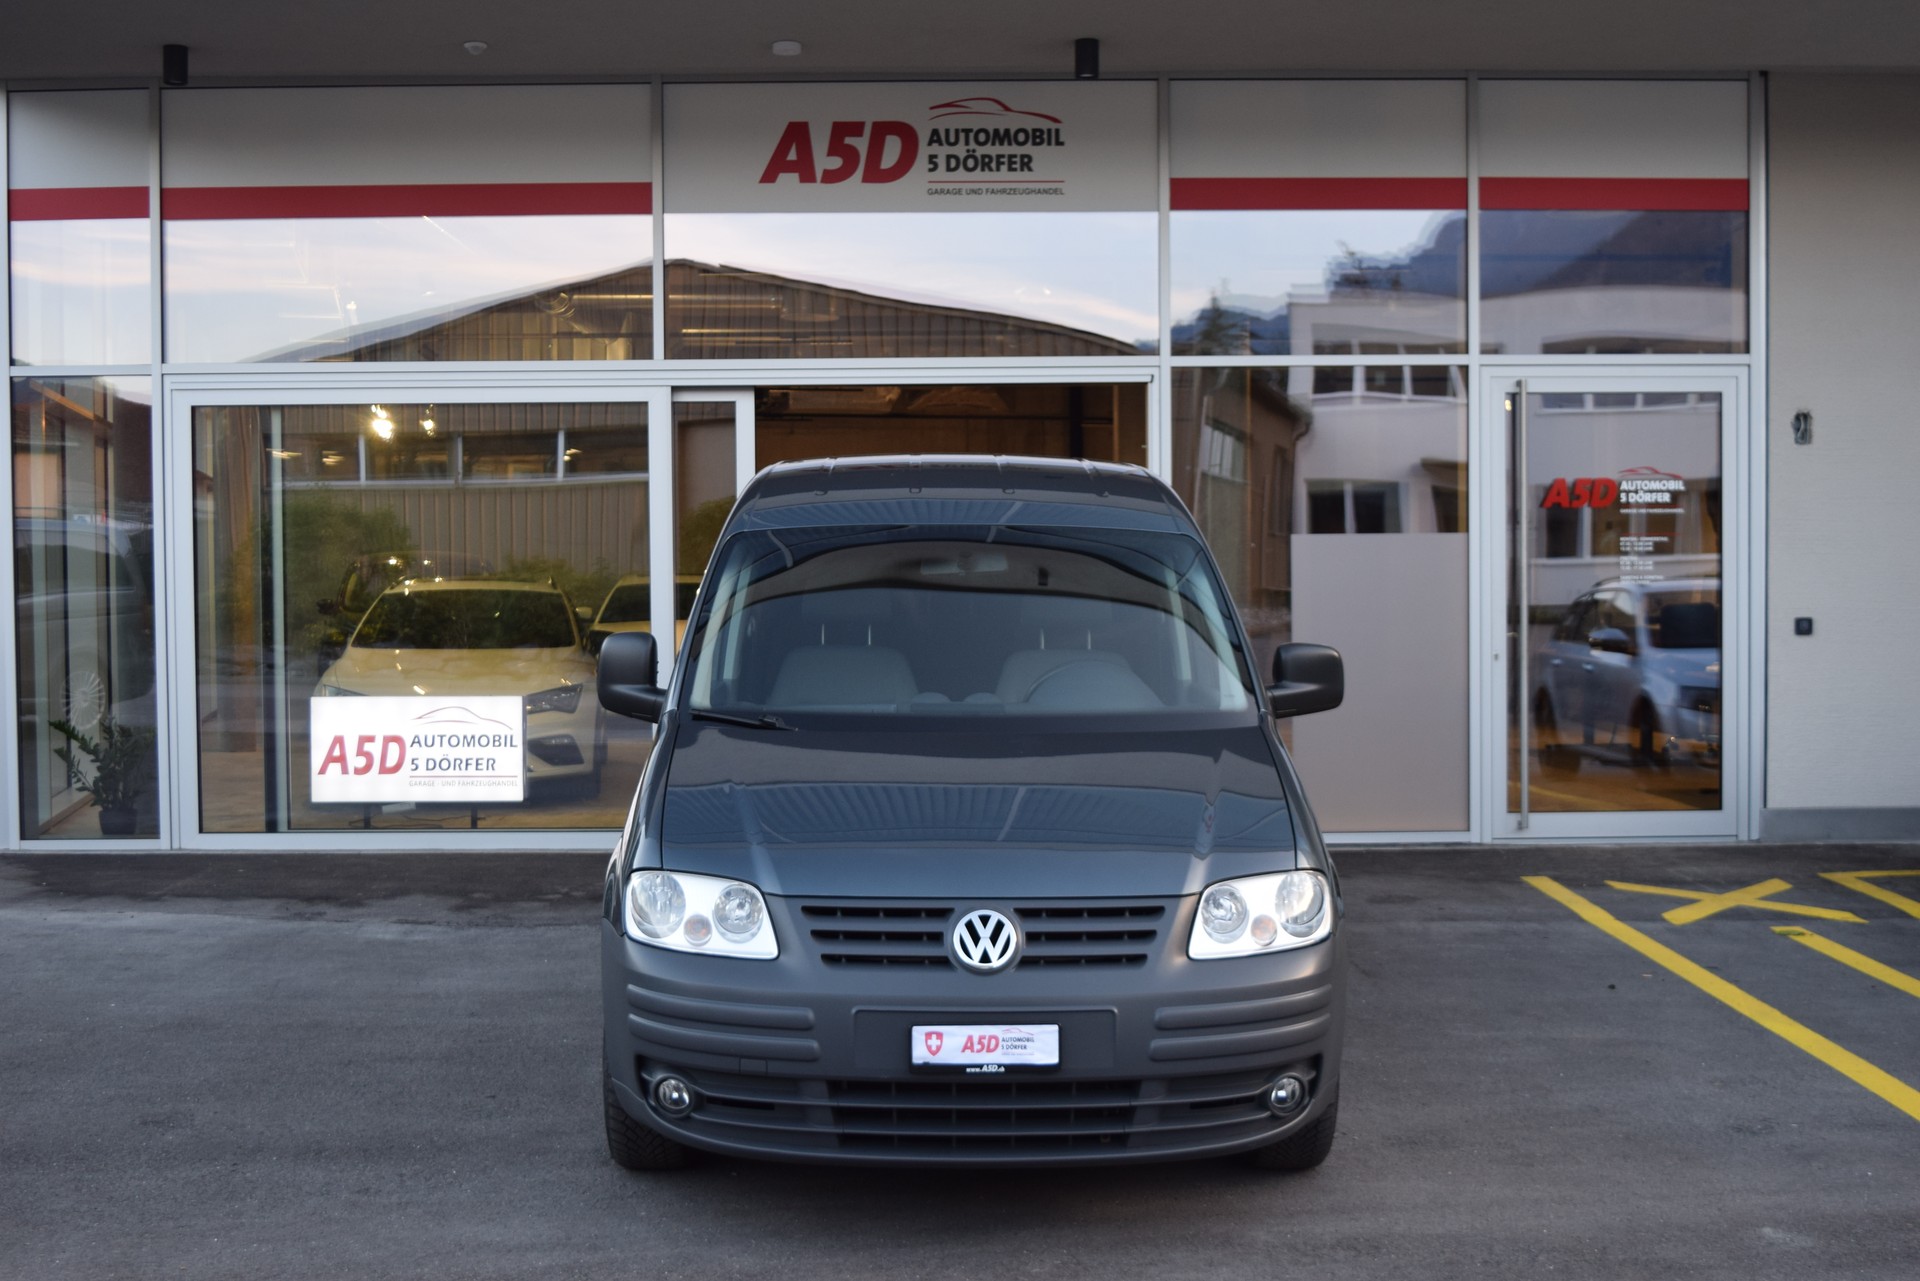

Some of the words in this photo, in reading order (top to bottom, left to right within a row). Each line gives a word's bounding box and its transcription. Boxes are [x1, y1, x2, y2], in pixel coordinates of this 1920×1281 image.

[927, 128, 1065, 147] AUTOMOBIL
[758, 121, 919, 184] A5D
[927, 154, 939, 173] 5
[945, 149, 1034, 173] DÖRFER
[927, 188, 963, 196] GARAGE
[965, 188, 984, 196] UND
[985, 188, 1065, 196] FAHRZEUGHANDEL
[1541, 477, 1619, 509] A5D
[1619, 480, 1685, 490] AUTOMOBIL
[1628, 490, 1671, 503] DÖRFER
[409, 734, 518, 748] AUTOMOBIL
[317, 734, 407, 775] A5D
[410, 758, 419, 771] 5
[425, 754, 496, 771] DÖRFER
[961, 1034, 1000, 1053] A5D
